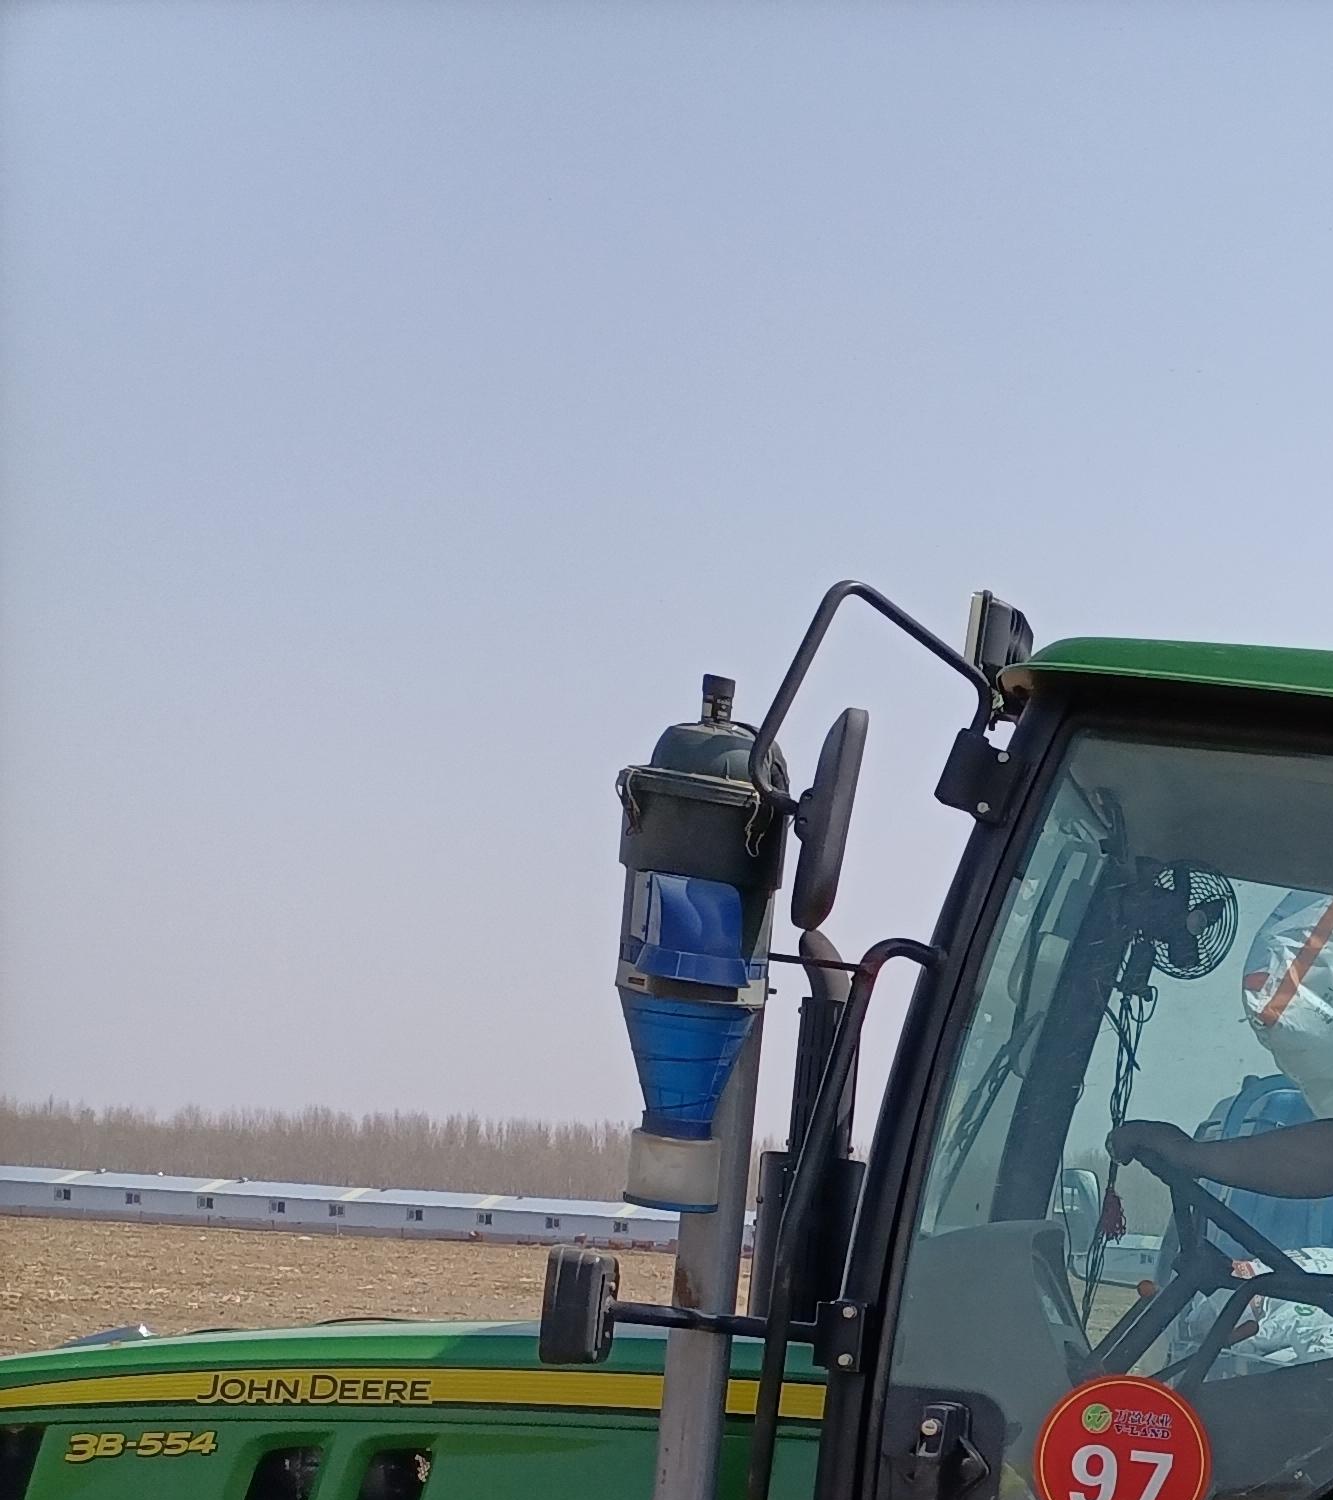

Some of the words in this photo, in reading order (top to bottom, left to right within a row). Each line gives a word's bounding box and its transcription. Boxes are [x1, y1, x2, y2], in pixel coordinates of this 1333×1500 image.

[198, 1374, 300, 1401] JOHN
[310, 1375, 432, 1401] DEERE
[65, 1431, 218, 1463] 3B-554
